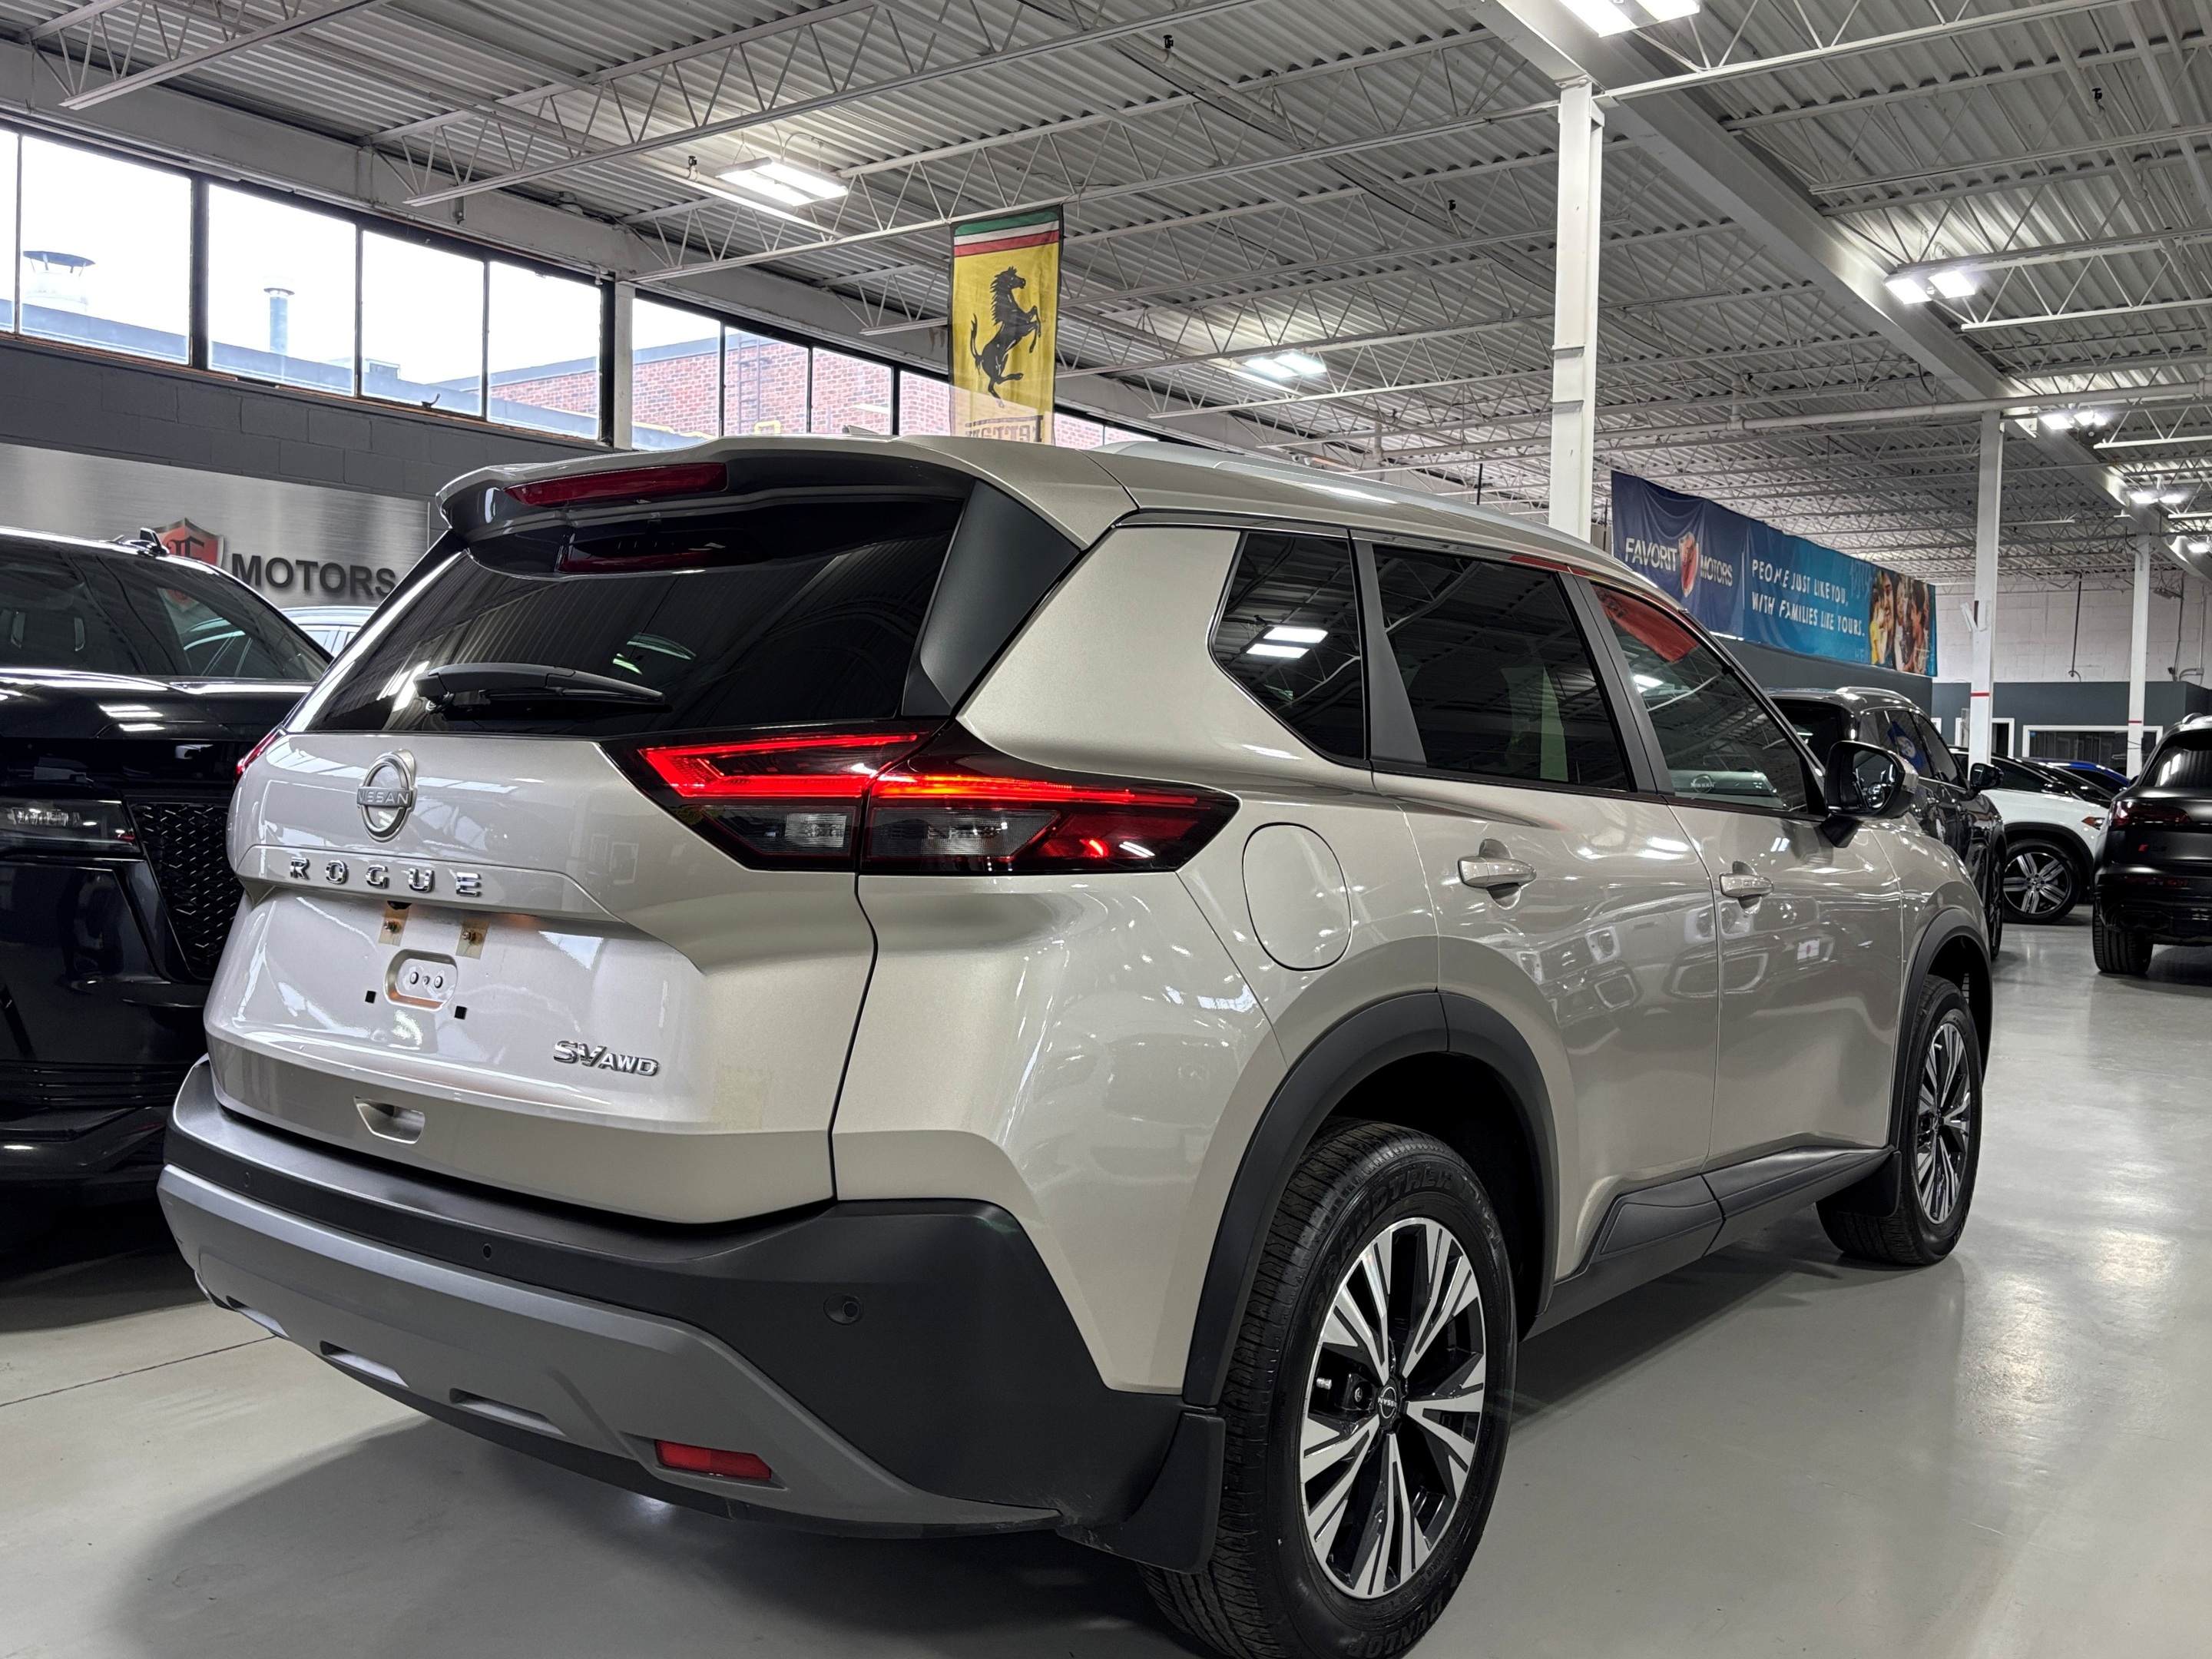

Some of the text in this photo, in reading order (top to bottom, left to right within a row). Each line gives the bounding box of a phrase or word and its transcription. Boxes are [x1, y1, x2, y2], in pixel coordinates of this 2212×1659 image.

[231, 553, 396, 597] MOTORS
[1624, 537, 1734, 587] FAVORIT MOTORS
[1791, 572, 1810, 594] JUST
[1813, 578, 1830, 599] LIKE
[1752, 591, 1776, 615] WITH
[1779, 600, 1818, 627] FAMILIES
[1820, 611, 1834, 631] LIKE
[357, 789, 409, 806] NISSAN
[290, 856, 483, 897] ROGUE
